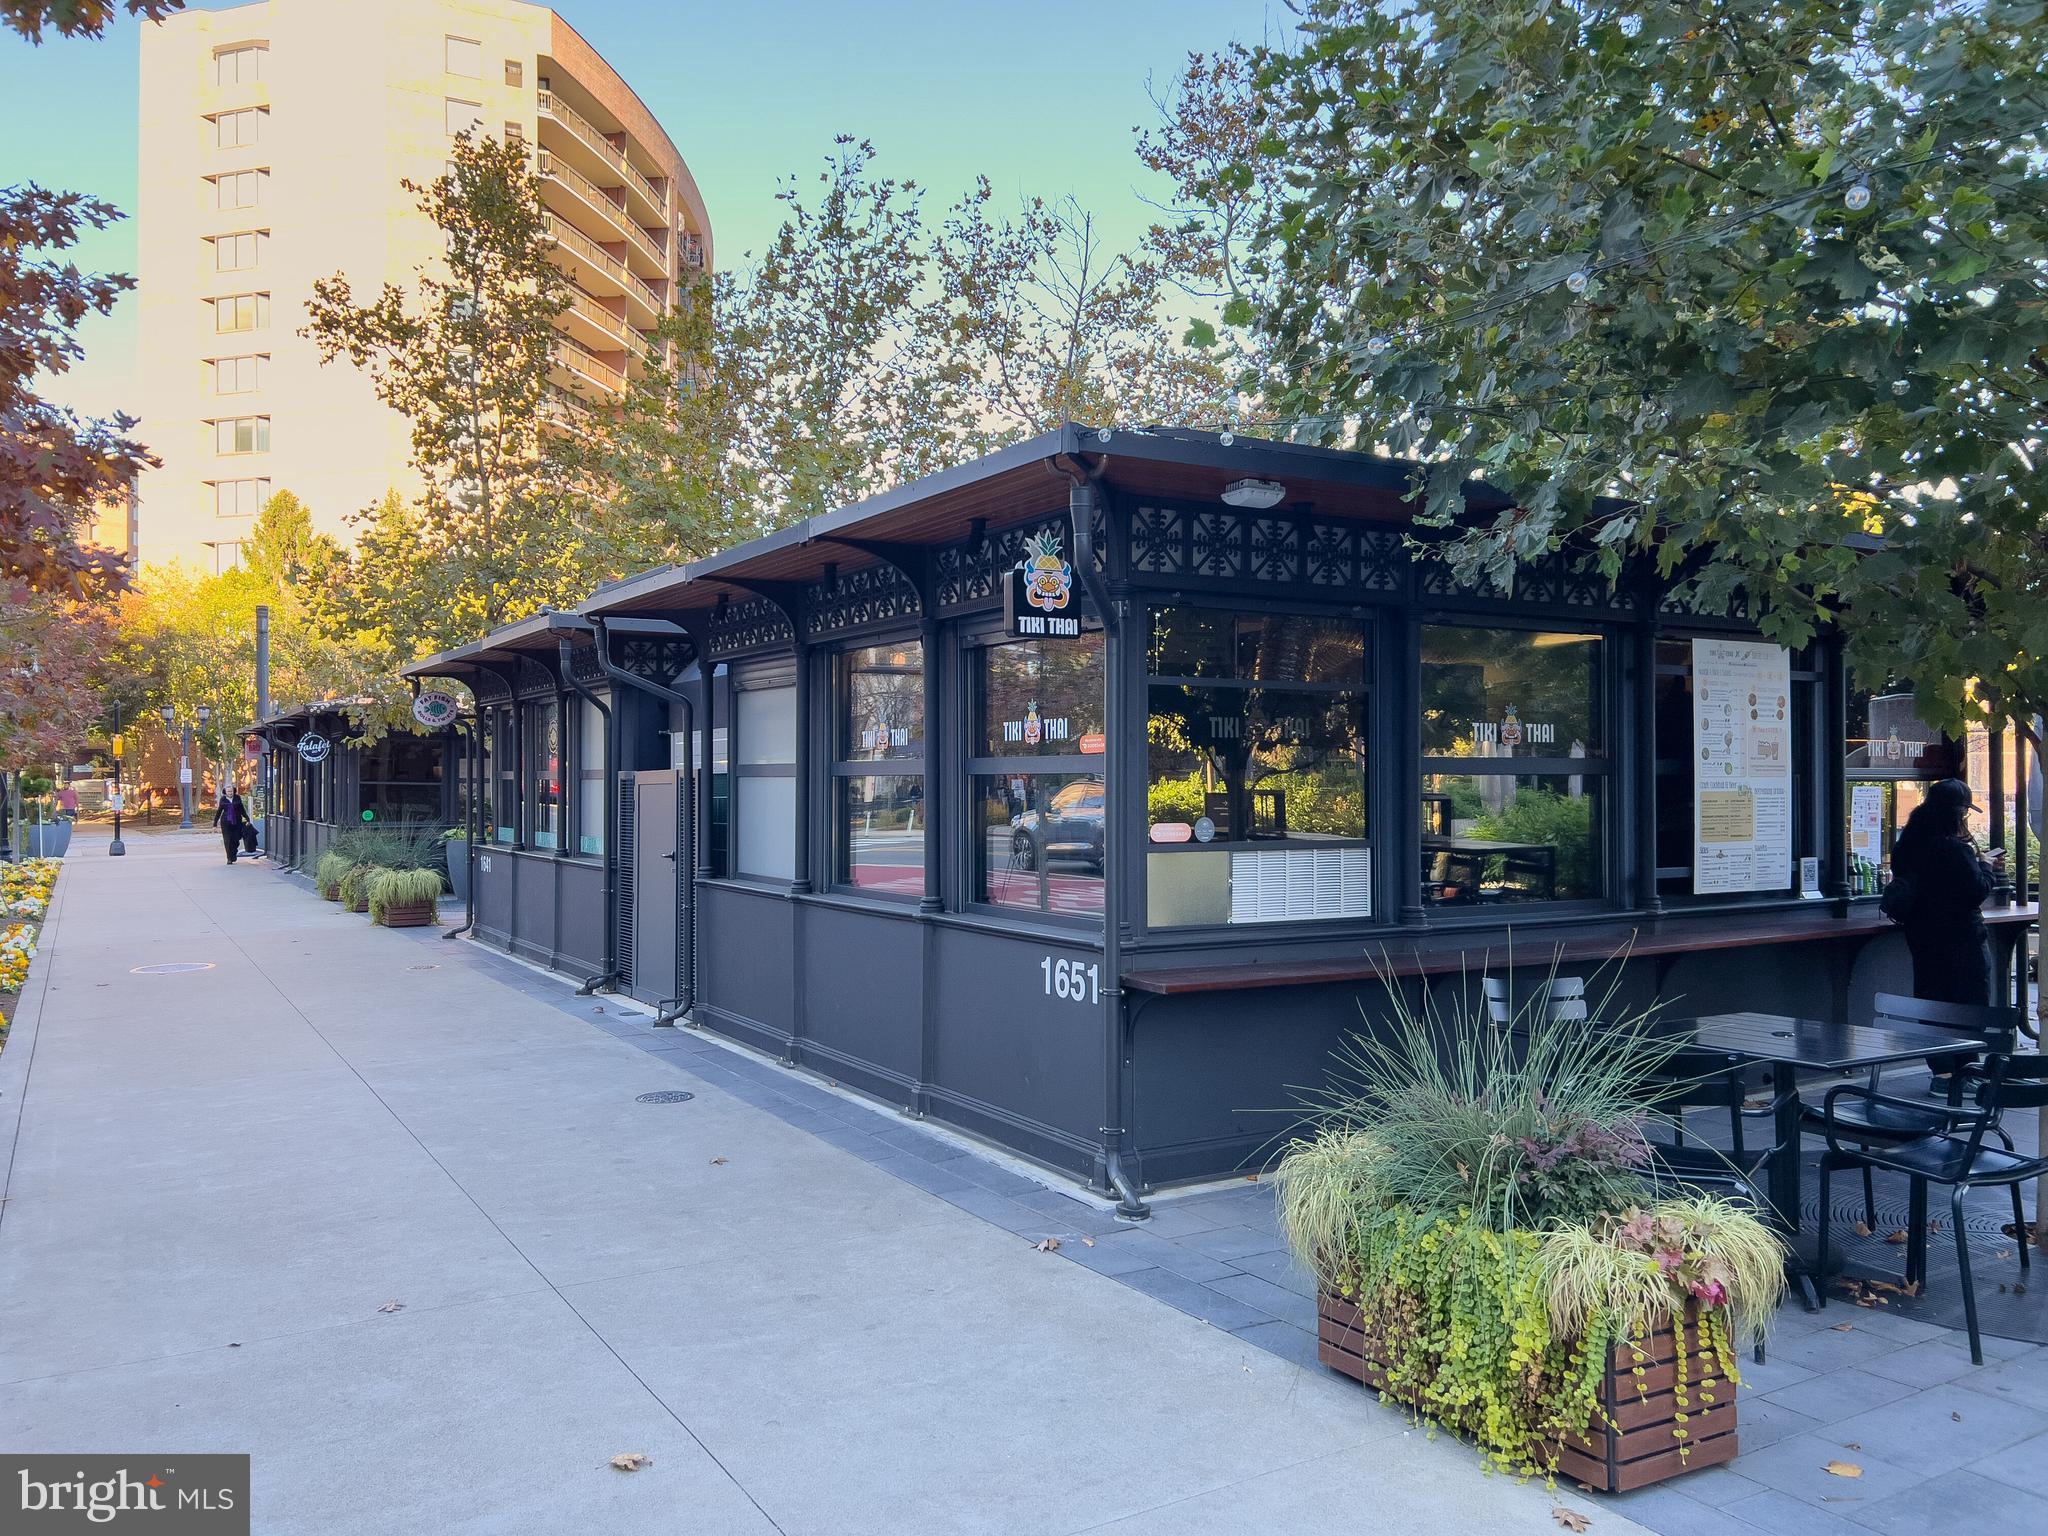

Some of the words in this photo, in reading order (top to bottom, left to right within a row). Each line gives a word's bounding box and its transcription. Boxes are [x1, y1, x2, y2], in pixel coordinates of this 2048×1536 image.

[1018, 616, 1045, 634] TIKI
[1047, 617, 1079, 635] THAI
[420, 695, 432, 705] FAT
[434, 694, 451, 705] FISH
[861, 730, 876, 748] TIKI
[890, 727, 909, 747] THAI
[1003, 720, 1022, 742] TIKI
[1044, 717, 1068, 740] THAI
[1208, 716, 1240, 739] TIKI
[1471, 722, 1497, 742] TIKI
[1525, 723, 1555, 743] THAI
[296, 739, 331, 753] Falafel
[1867, 740, 1885, 757] TIKI
[1903, 741, 1924, 757] THAI
[1040, 956, 1098, 1005] 1651
